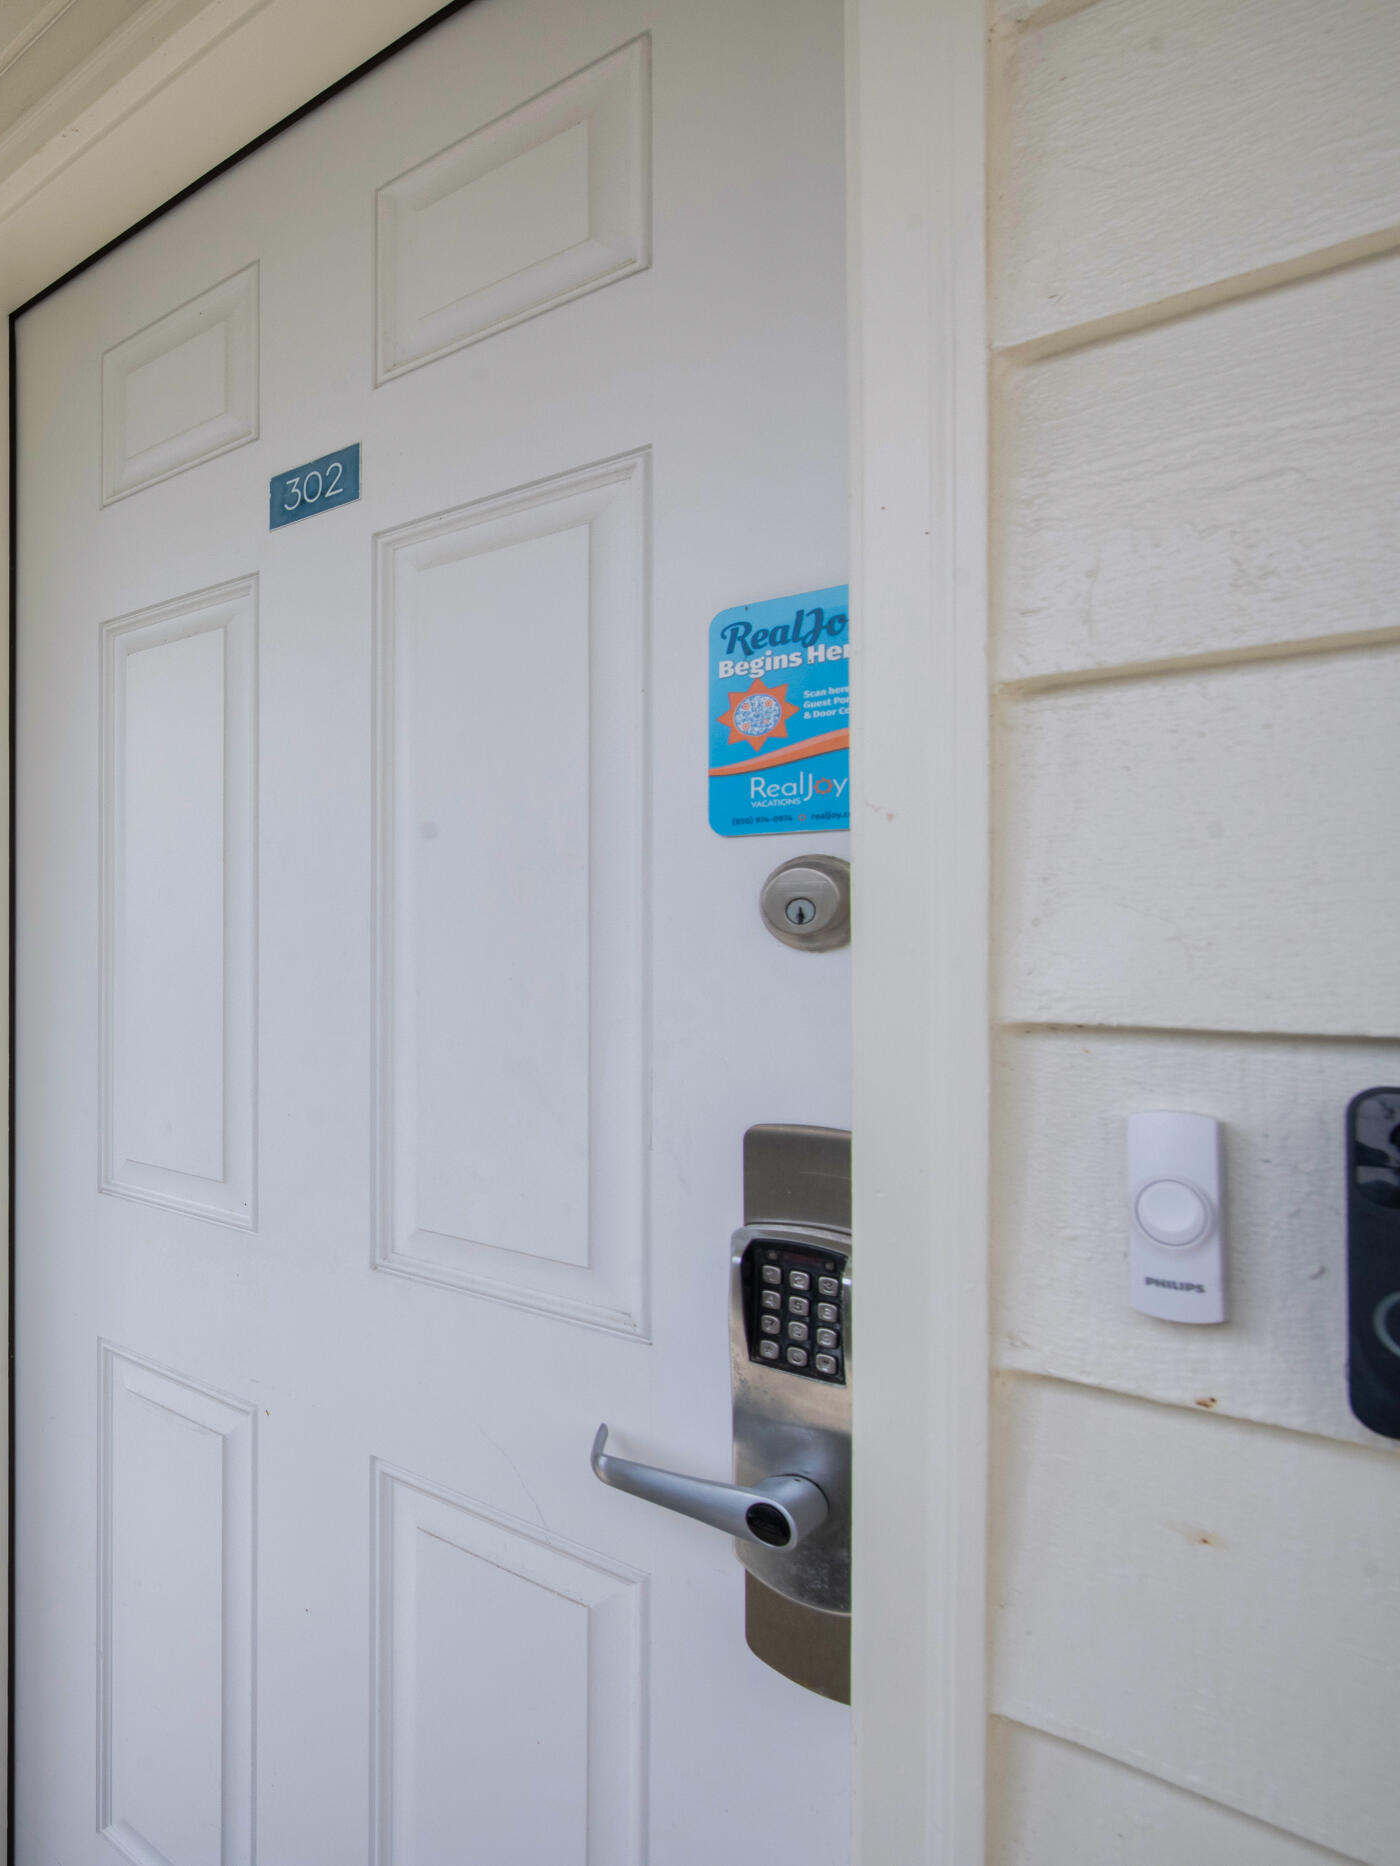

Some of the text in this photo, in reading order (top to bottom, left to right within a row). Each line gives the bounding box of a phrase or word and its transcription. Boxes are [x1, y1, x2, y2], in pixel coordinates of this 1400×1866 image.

[284, 462, 343, 511] 302
[718, 650, 803, 679] Begins
[803, 689, 826, 699] Scan
[803, 698, 832, 708] Guest
[803, 711, 811, 720] &
[813, 709, 836, 718] Door
[750, 771, 849, 801] RealJoy
[751, 797, 802, 808] VACATIONS
[1145, 1276, 1206, 1293] PHILIPS
